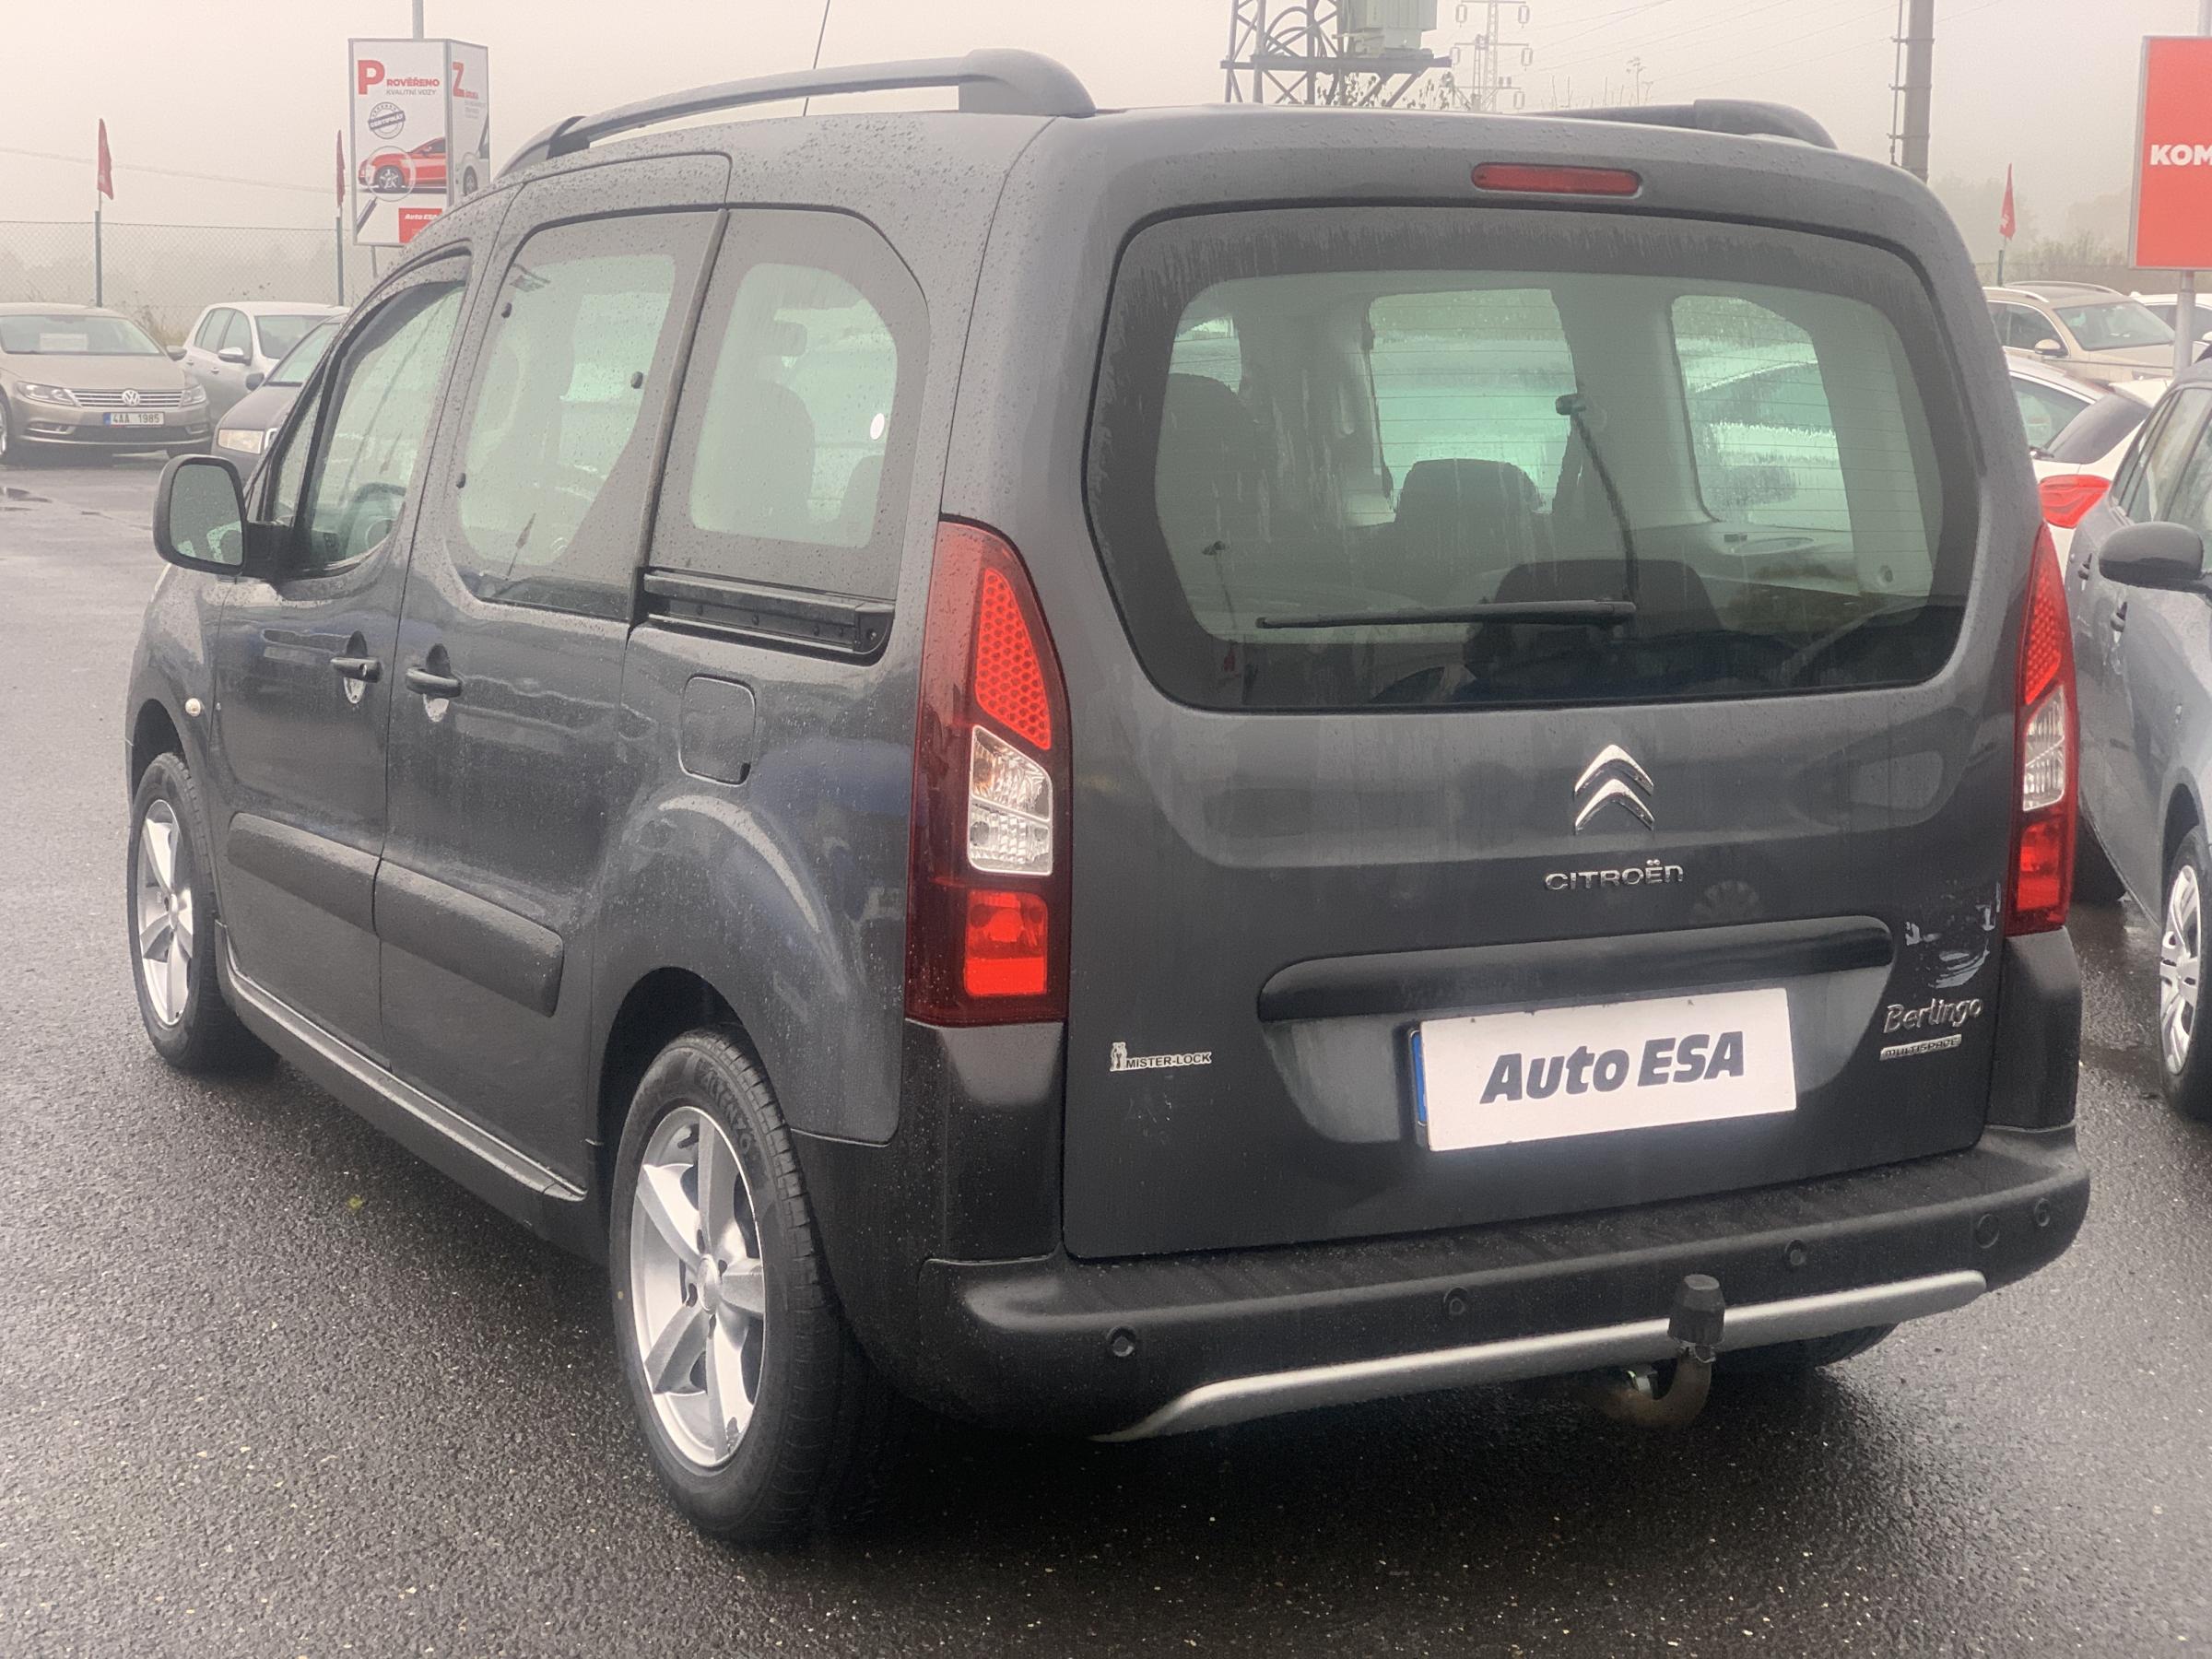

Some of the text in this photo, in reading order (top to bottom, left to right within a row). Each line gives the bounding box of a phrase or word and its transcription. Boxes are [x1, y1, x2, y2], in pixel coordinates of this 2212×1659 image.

[2149, 144, 2212, 166] KOM
[112, 413, 160, 423] 4AA 1985
[1545, 859, 1685, 890] CITROËN
[1883, 998, 1983, 1033] Berlingo
[1125, 1052, 1211, 1069] MISTER-LOCK
[1479, 1030, 1745, 1104] Auto ESA
